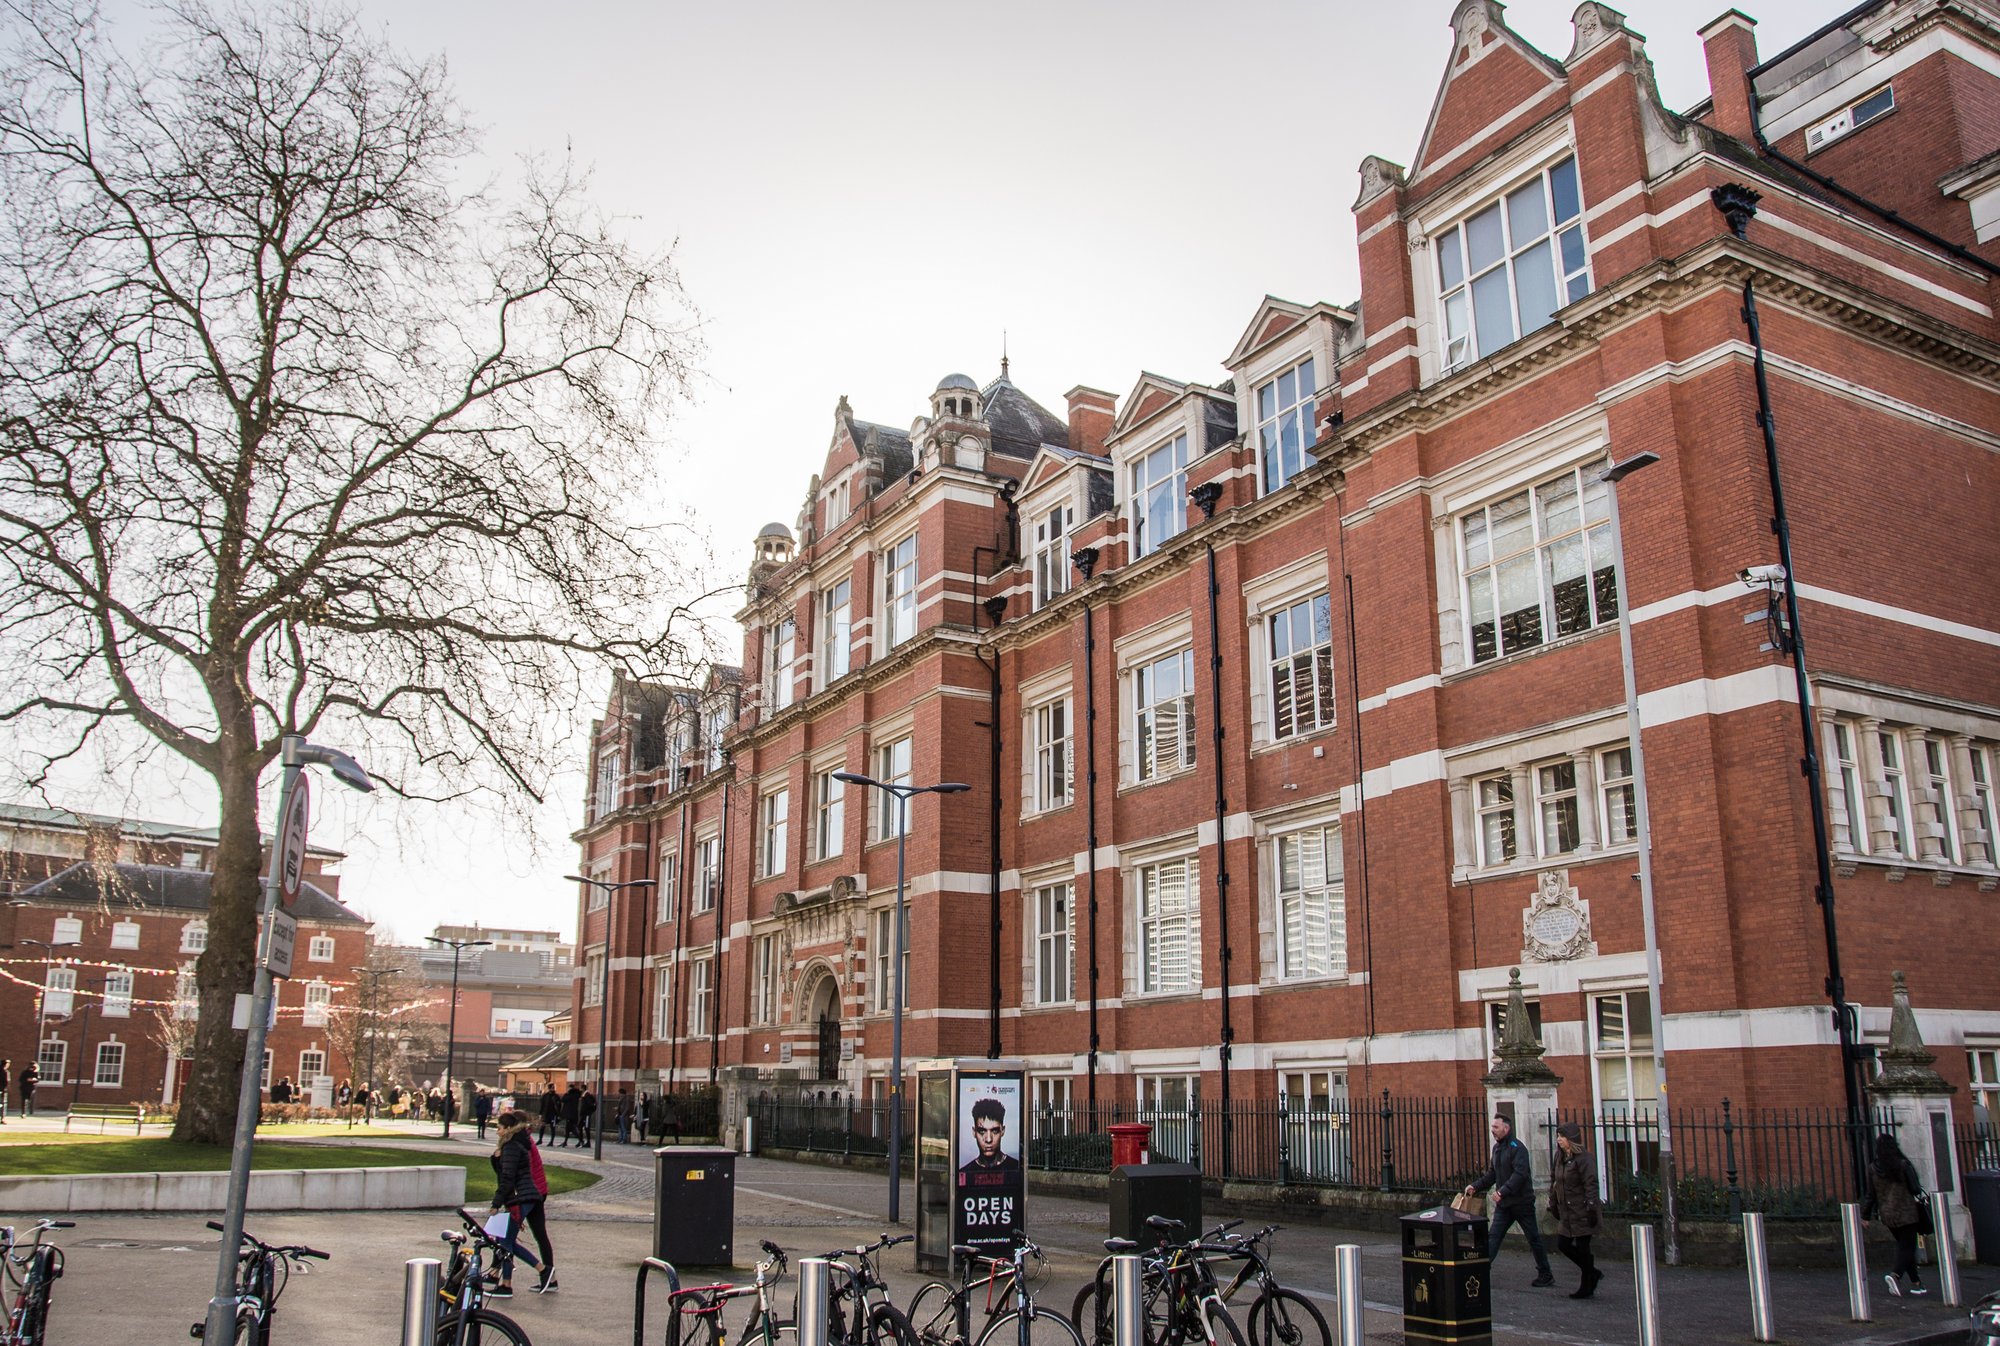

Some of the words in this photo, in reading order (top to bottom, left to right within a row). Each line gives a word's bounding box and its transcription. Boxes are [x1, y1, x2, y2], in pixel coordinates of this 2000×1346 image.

[964, 1197, 1013, 1211] OPEN
[966, 1211, 1011, 1225] DAYS
[1413, 1250, 1432, 1259] Litter
[1464, 1251, 1479, 1259] Litter
